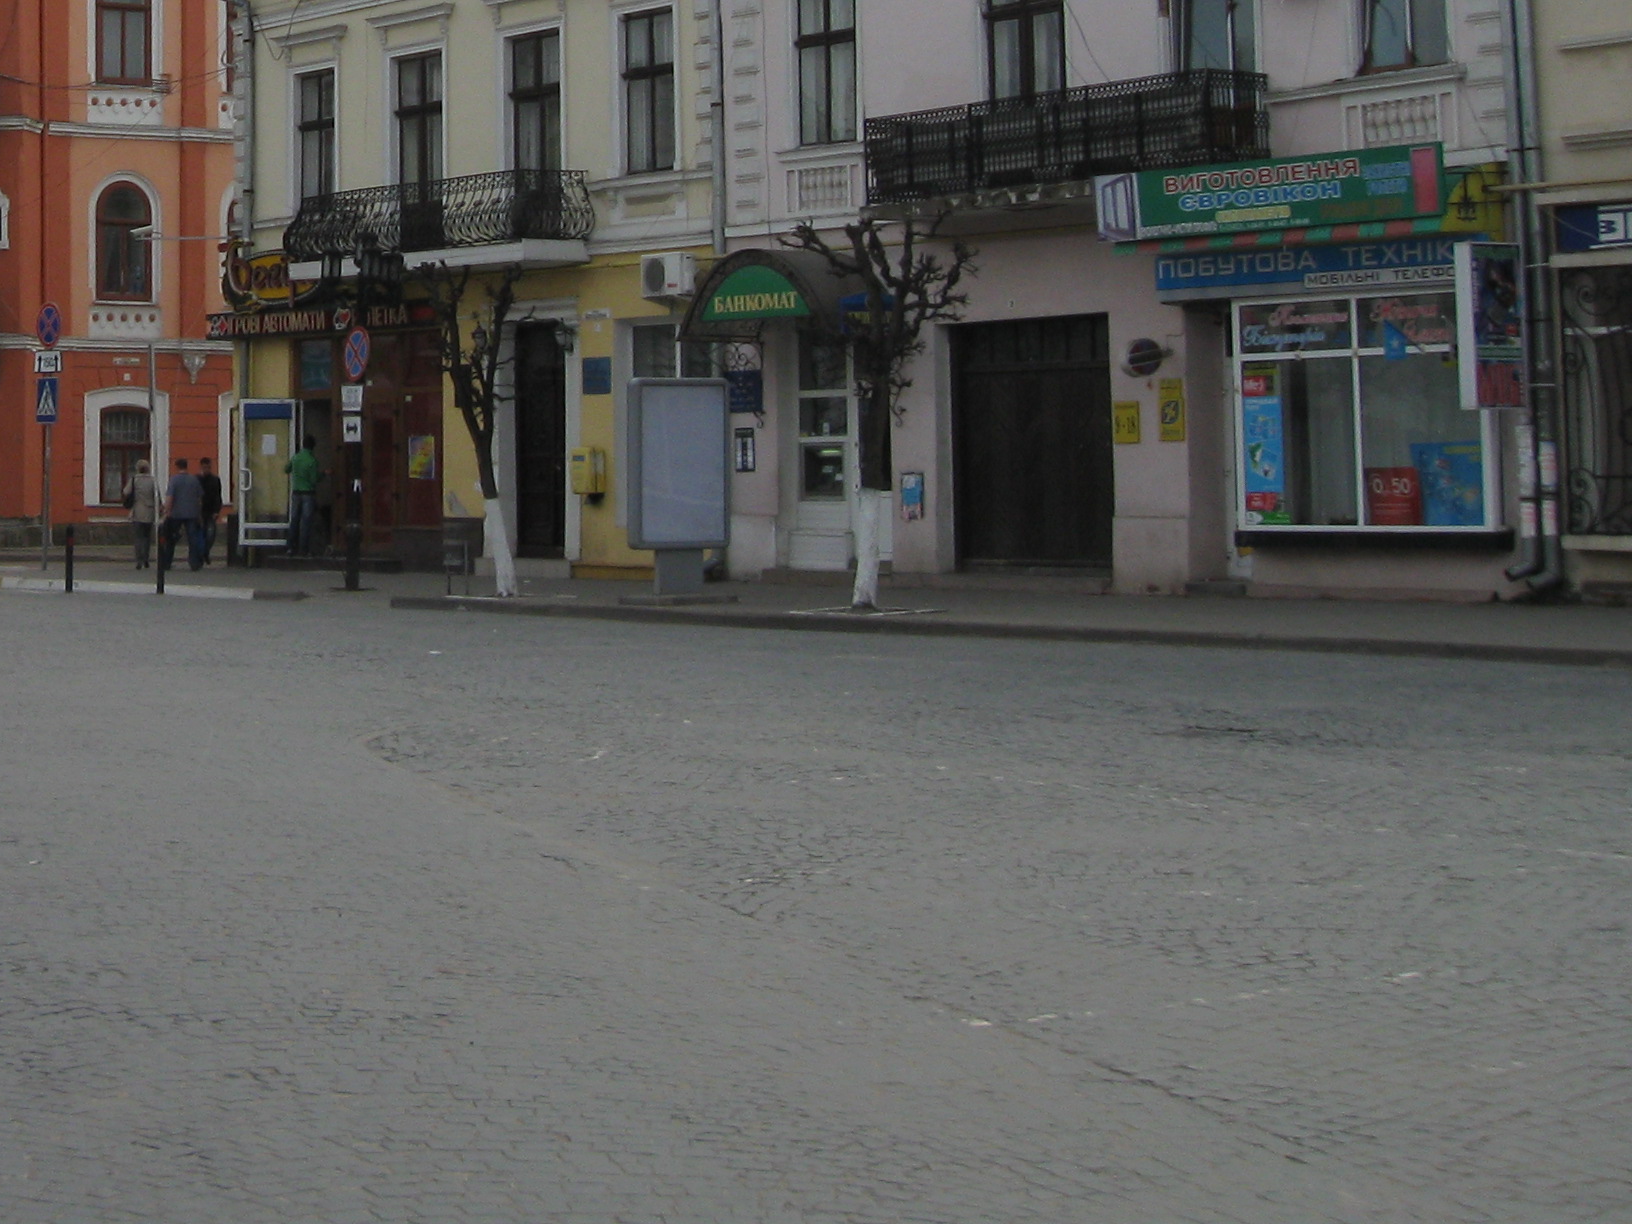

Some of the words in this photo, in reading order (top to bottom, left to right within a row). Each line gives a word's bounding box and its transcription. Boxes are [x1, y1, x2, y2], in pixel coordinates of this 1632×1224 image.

[1163, 157, 1360, 194] ВИГОТОВЛЕННЯ
[1179, 180, 1342, 211] ЄВРОВІКОН
[1158, 251, 1318, 280] ПОБУТОВА
[1307, 271, 1381, 286] МОБІЛЬНІ
[714, 291, 798, 313] БАНКОМАТ
[262, 310, 325, 334] АВТОМАТИ
